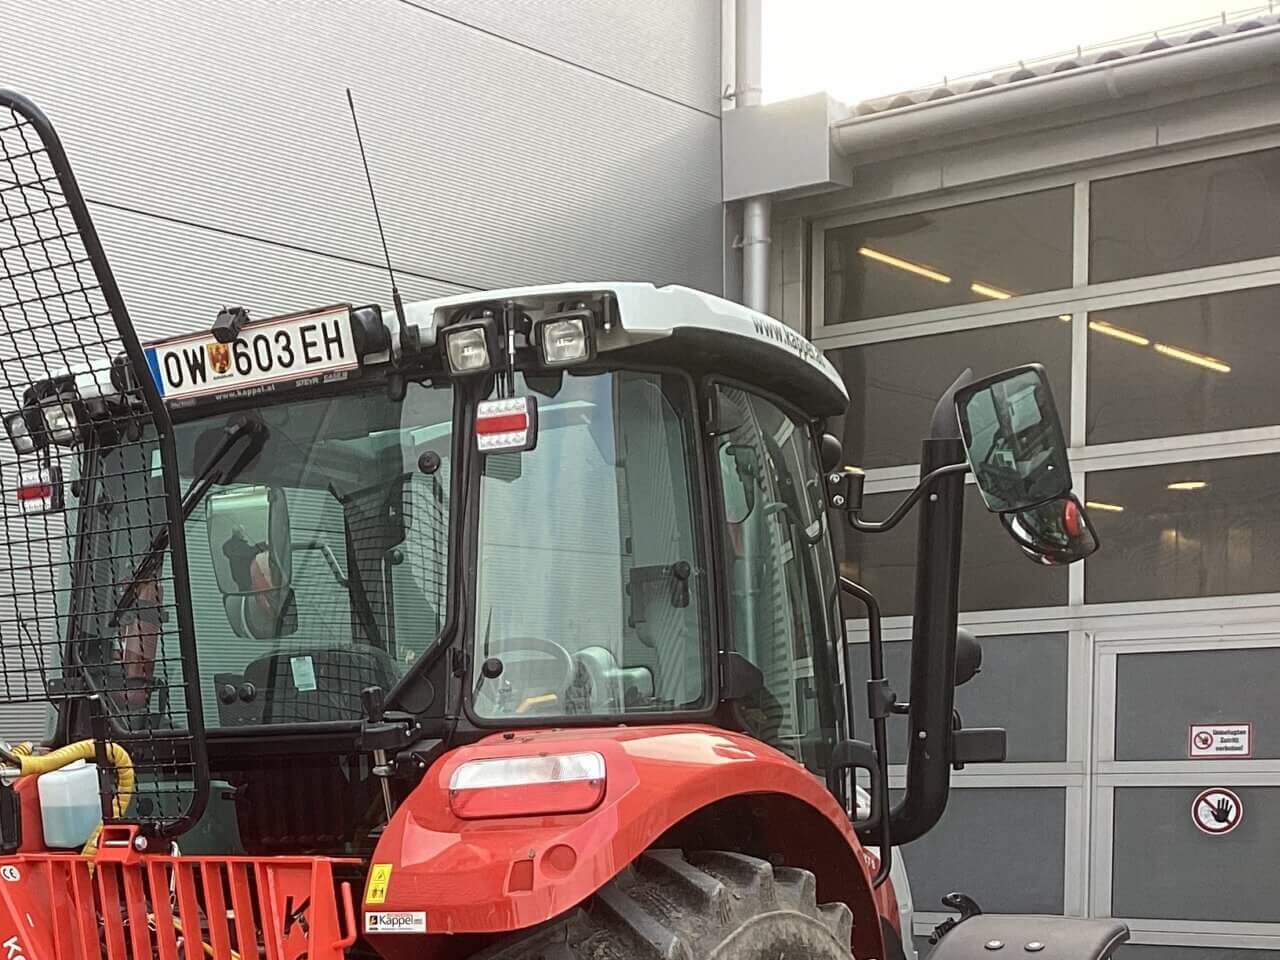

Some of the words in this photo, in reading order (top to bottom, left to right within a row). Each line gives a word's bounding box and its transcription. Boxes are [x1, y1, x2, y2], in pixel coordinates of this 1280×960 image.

[163, 345, 208, 388] OW
[231, 330, 295, 376] 603
[298, 319, 345, 364] EH
[379, 914, 414, 928] Kappel
